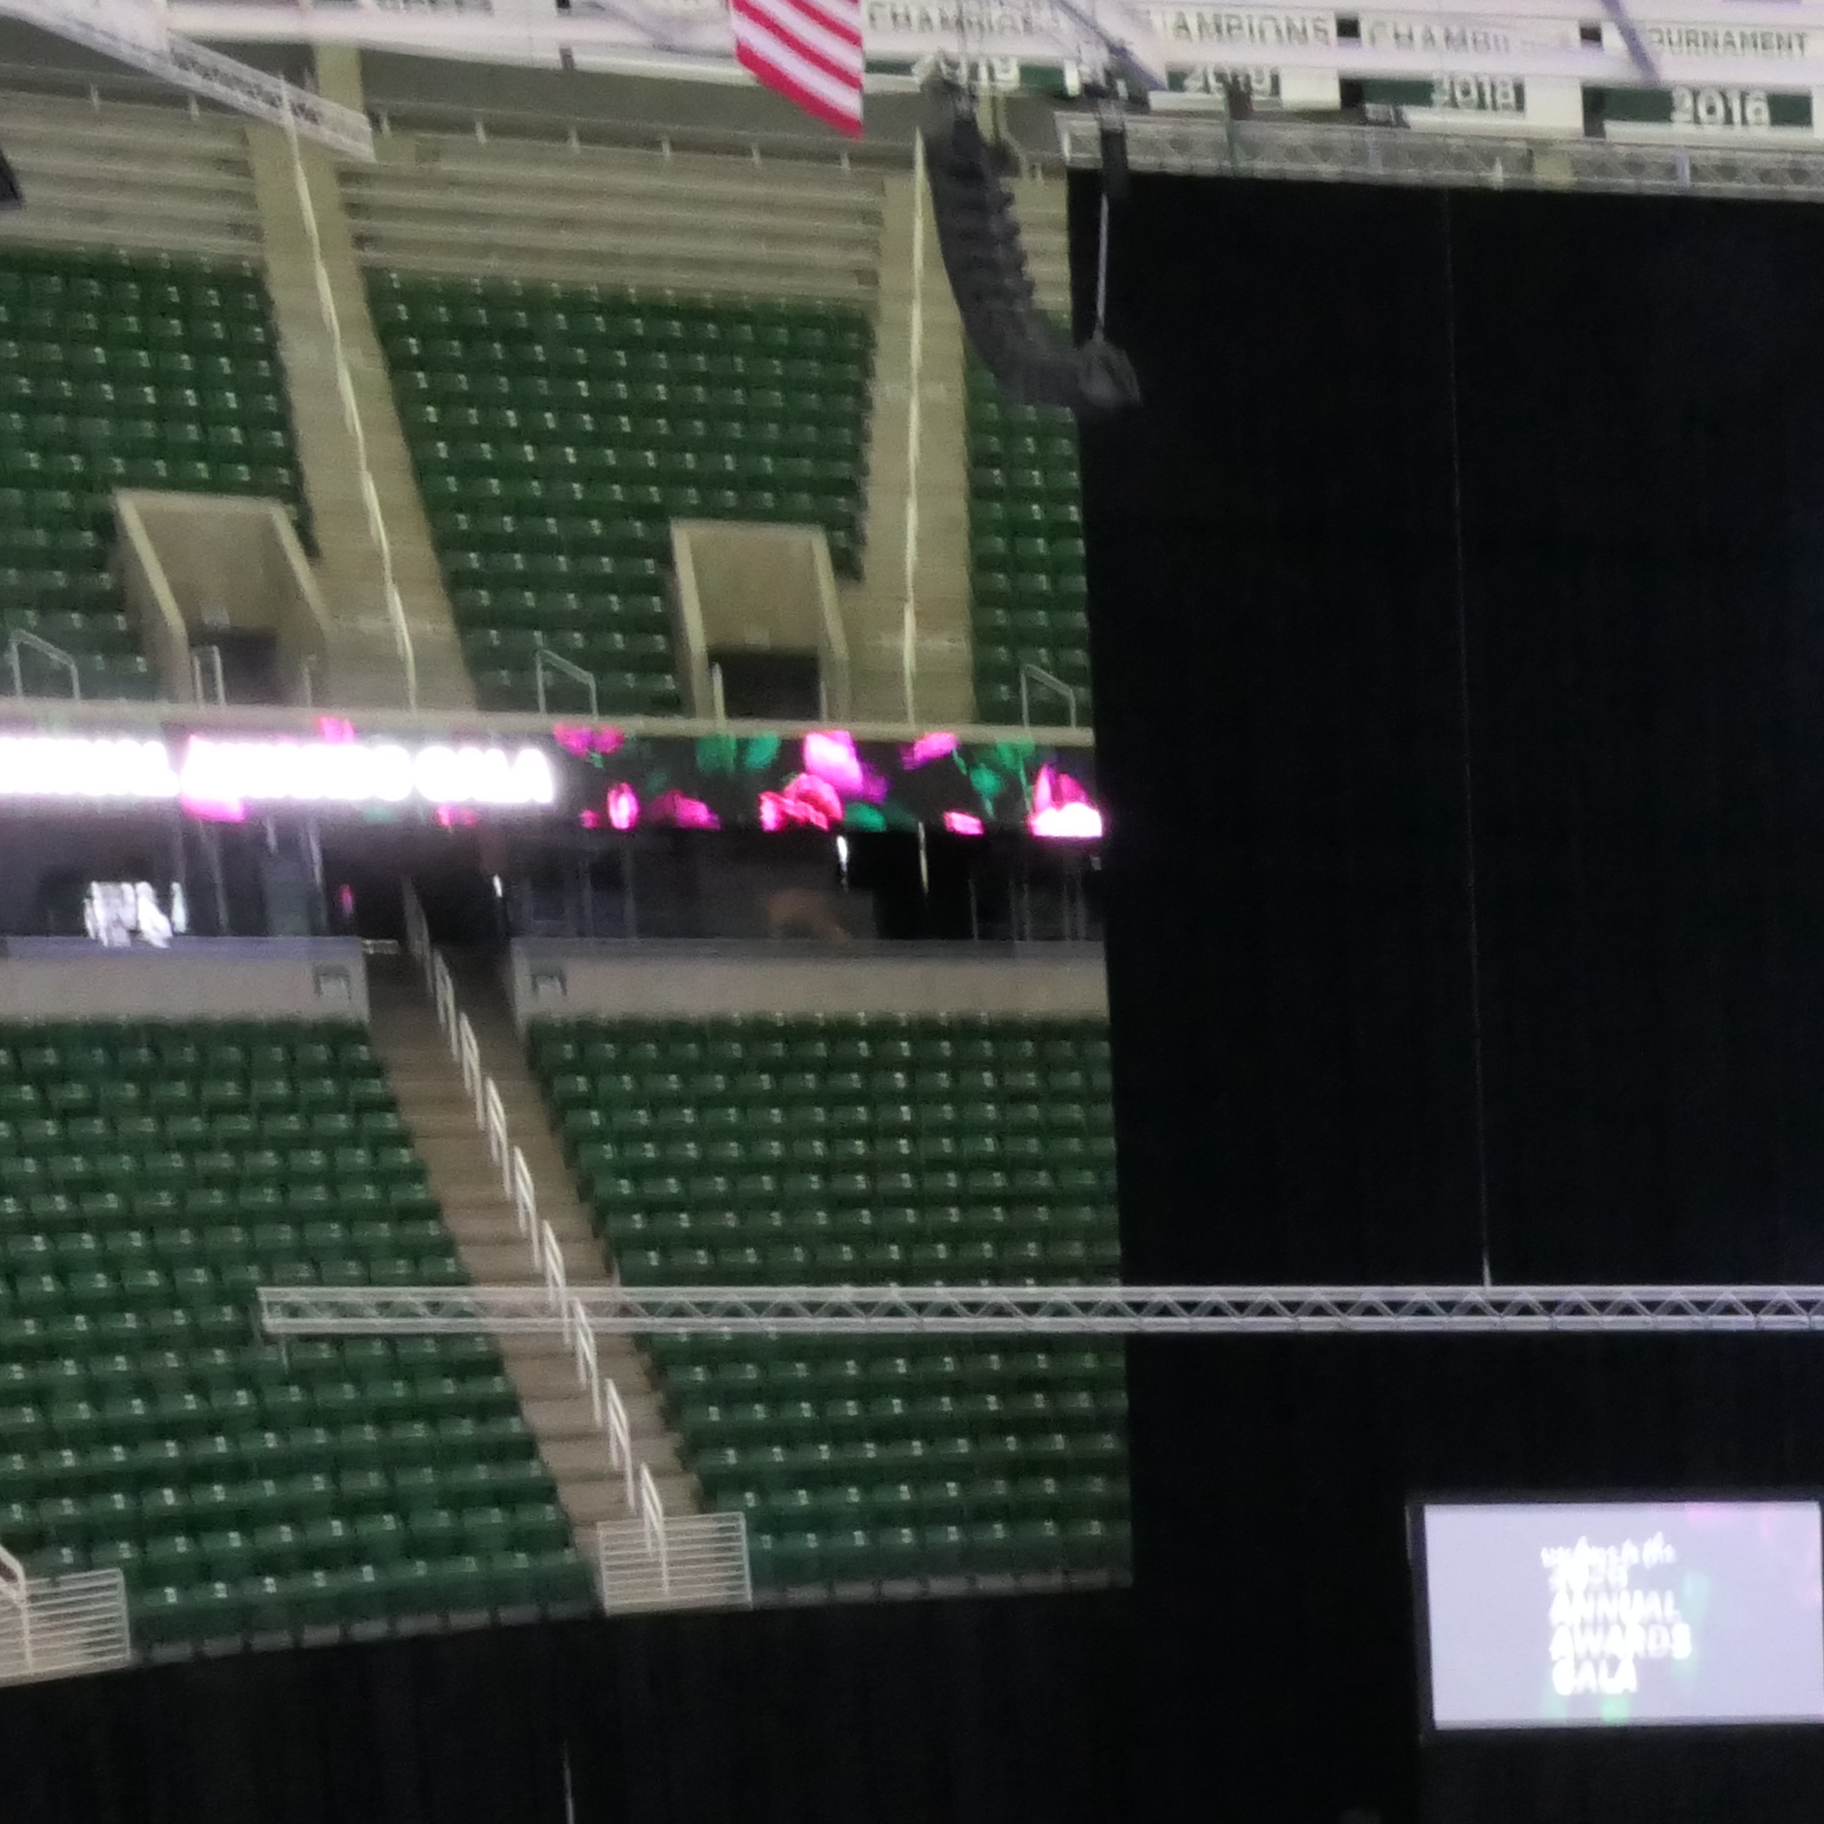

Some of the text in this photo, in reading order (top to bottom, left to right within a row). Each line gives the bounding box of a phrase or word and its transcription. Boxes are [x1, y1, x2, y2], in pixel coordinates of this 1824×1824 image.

[1172, 11, 1332, 45] AMPIONS
[1647, 27, 1807, 58] OURNAMENT
[1670, 88, 1769, 126] 2016
[1550, 1590, 1682, 1626] ANNUAL
[1550, 1624, 1692, 1660] AWARDS
[1552, 1658, 1637, 1695] GALA
